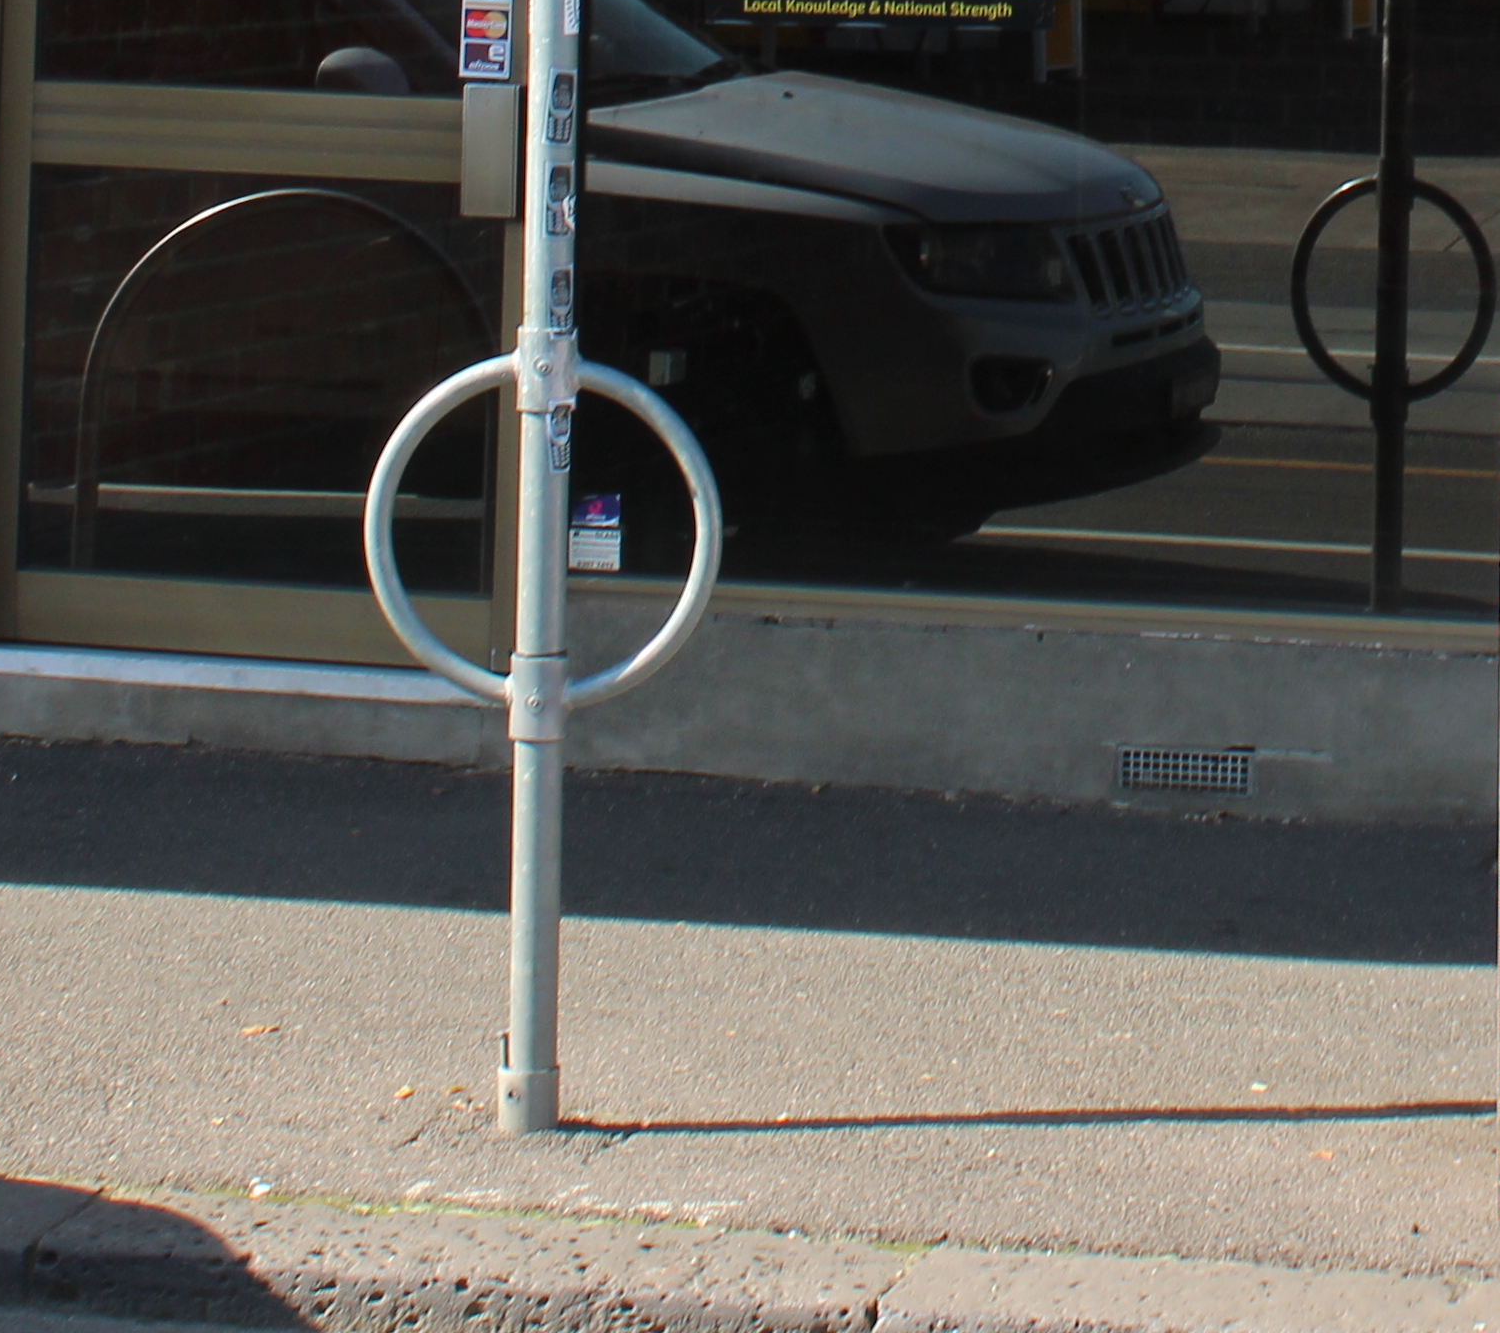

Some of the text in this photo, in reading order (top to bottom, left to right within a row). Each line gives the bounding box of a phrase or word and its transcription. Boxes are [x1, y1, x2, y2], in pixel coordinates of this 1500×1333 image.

[785, 0, 866, 19] Knowledge
[868, 0, 881, 17] &
[884, 0, 947, 18] National
[950, 1, 1013, 21] Strength
